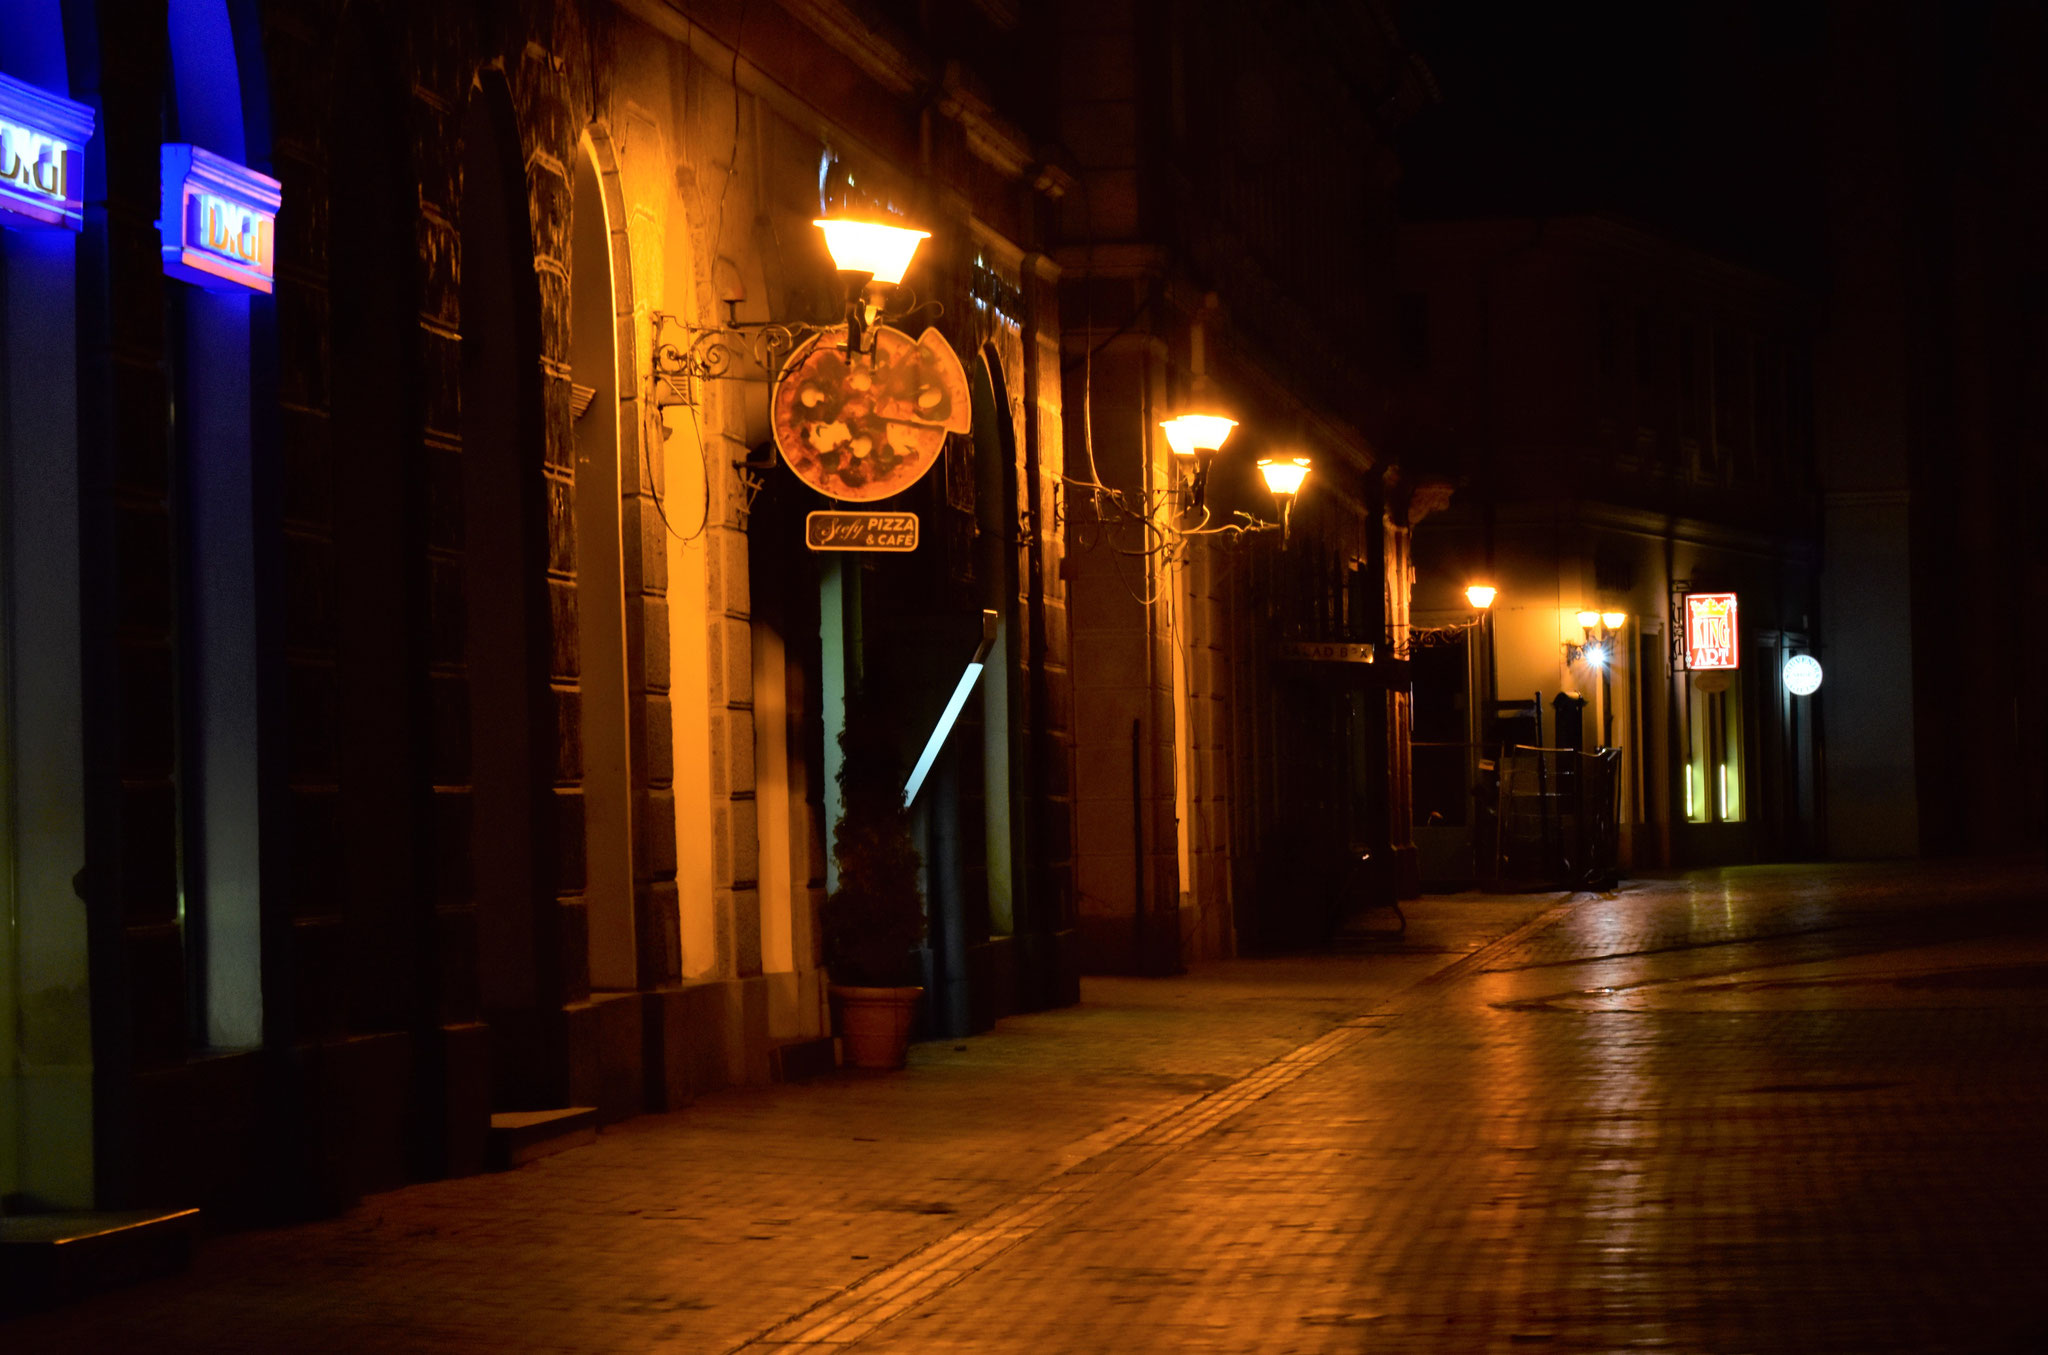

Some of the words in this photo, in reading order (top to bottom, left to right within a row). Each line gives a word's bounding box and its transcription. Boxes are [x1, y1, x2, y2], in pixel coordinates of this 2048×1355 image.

[867, 517, 915, 532] PIZZA
[866, 534, 875, 546] &
[877, 532, 915, 546] CAFÉ
[1692, 617, 1731, 649] KING
[1694, 648, 1729, 666] ART
